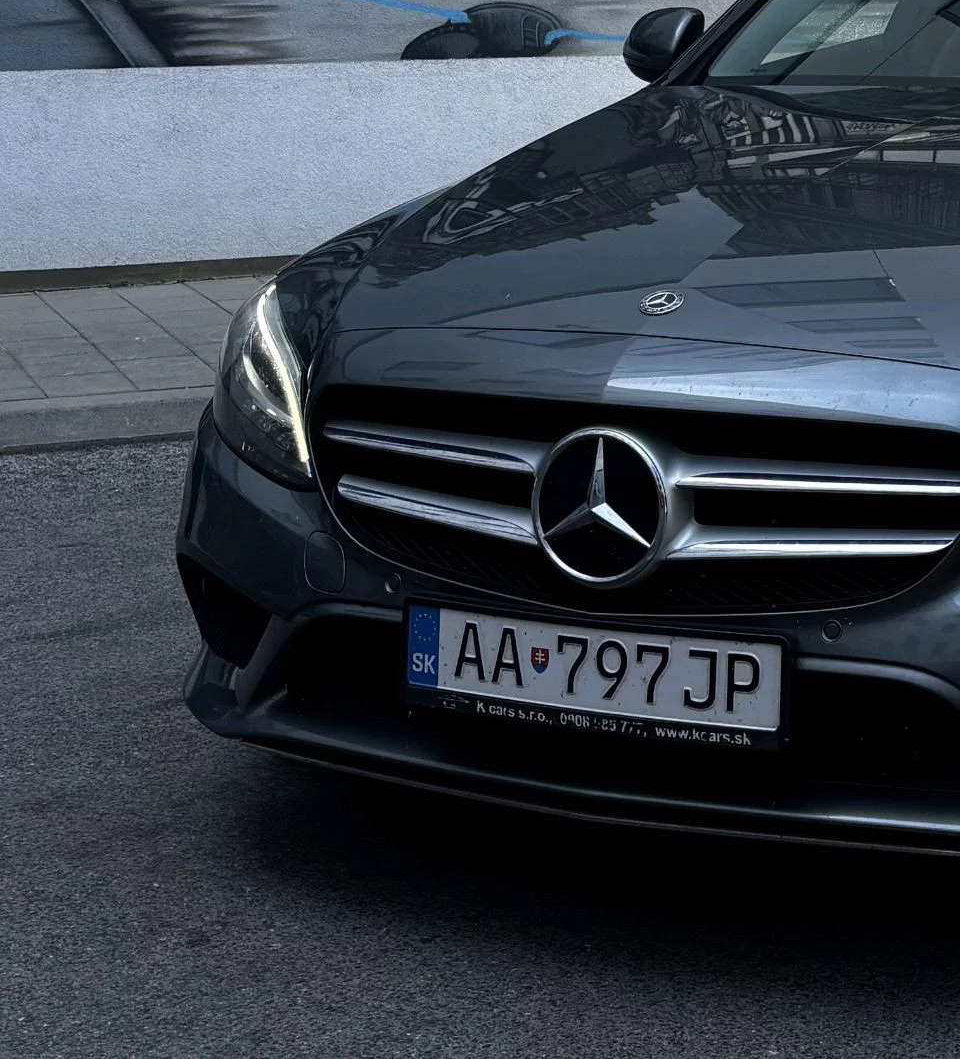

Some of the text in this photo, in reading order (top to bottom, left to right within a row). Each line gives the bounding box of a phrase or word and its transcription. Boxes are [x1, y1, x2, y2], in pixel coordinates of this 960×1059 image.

[411, 652, 436, 675] SK
[454, 620, 525, 689] AA
[654, 726, 752, 746] www.kcars.sk
